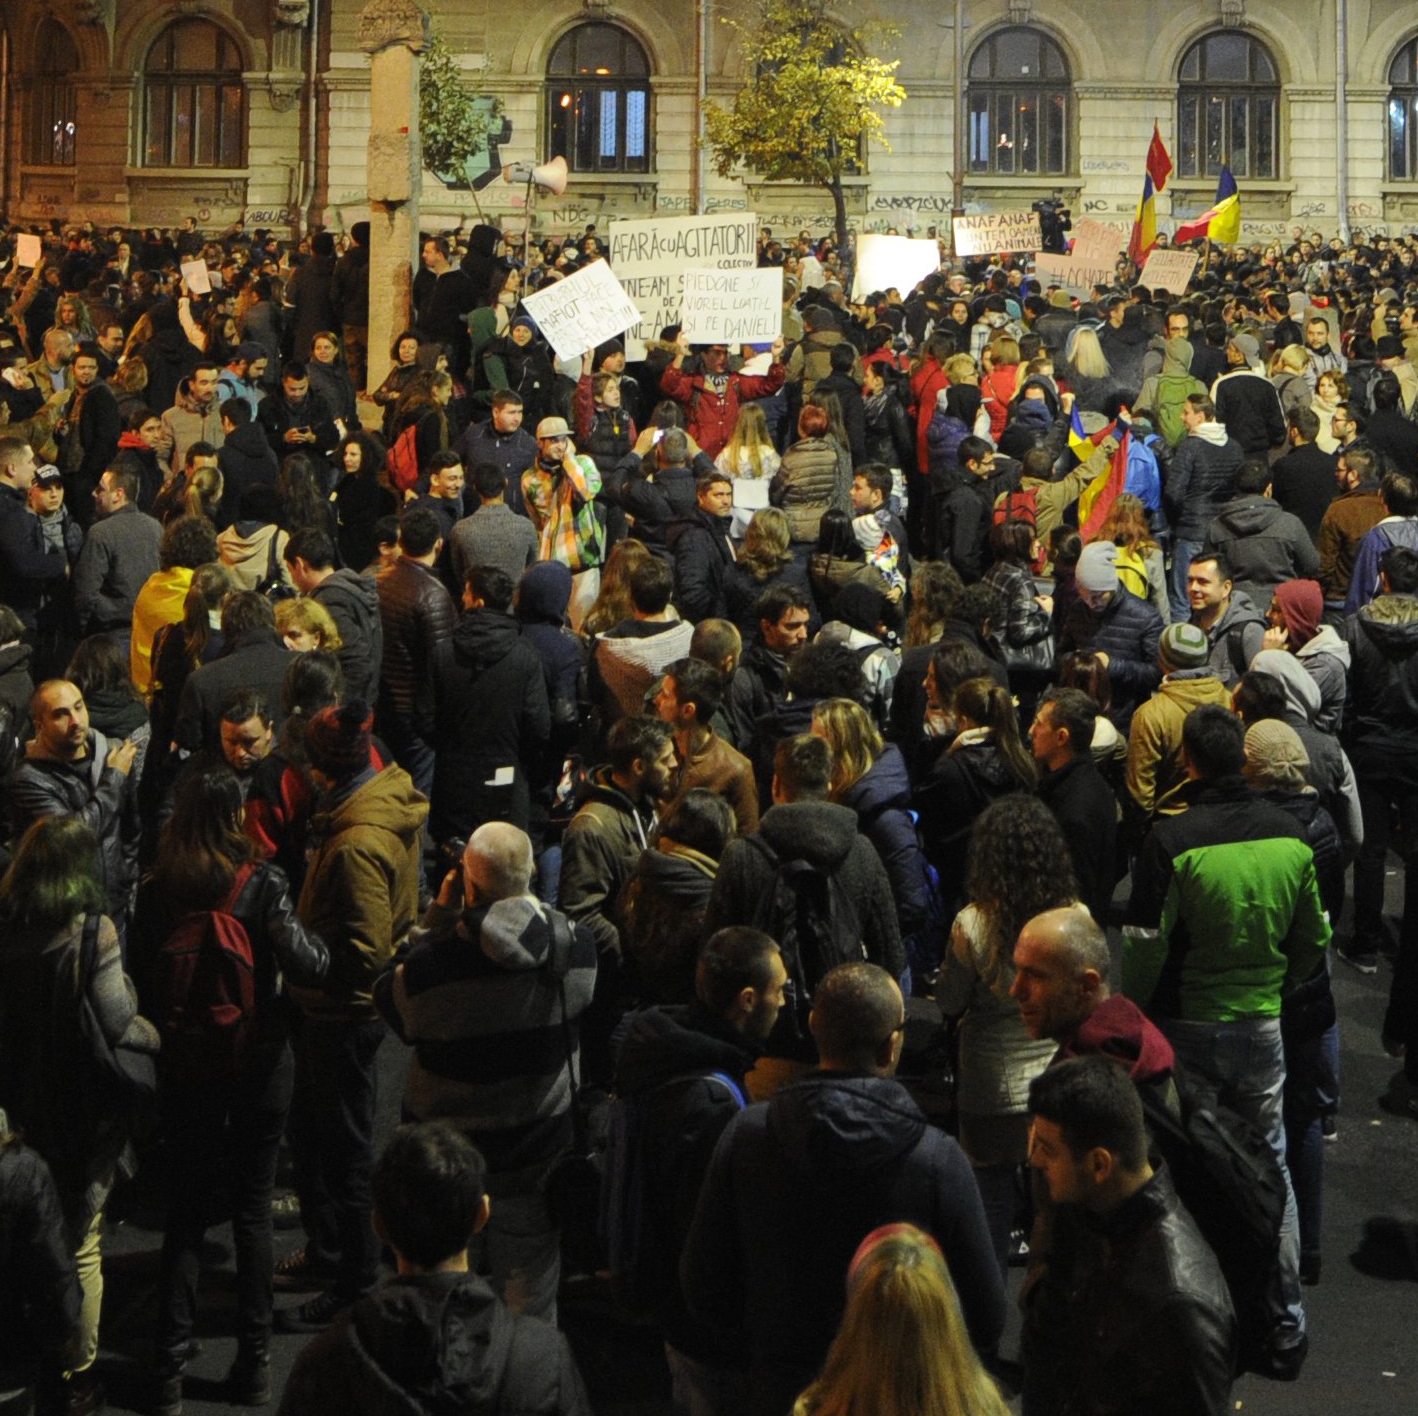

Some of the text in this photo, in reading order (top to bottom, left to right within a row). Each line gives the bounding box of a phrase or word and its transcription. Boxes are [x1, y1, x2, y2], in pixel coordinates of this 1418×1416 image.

[998, 212, 1035, 227] ANAF
[611, 227, 661, 264] AFARĂ
[675, 223, 756, 259] AGITATORII
[686, 296, 728, 311] VIOREL
[539, 298, 581, 333] MAFIOT
[705, 316, 718, 331] PE
